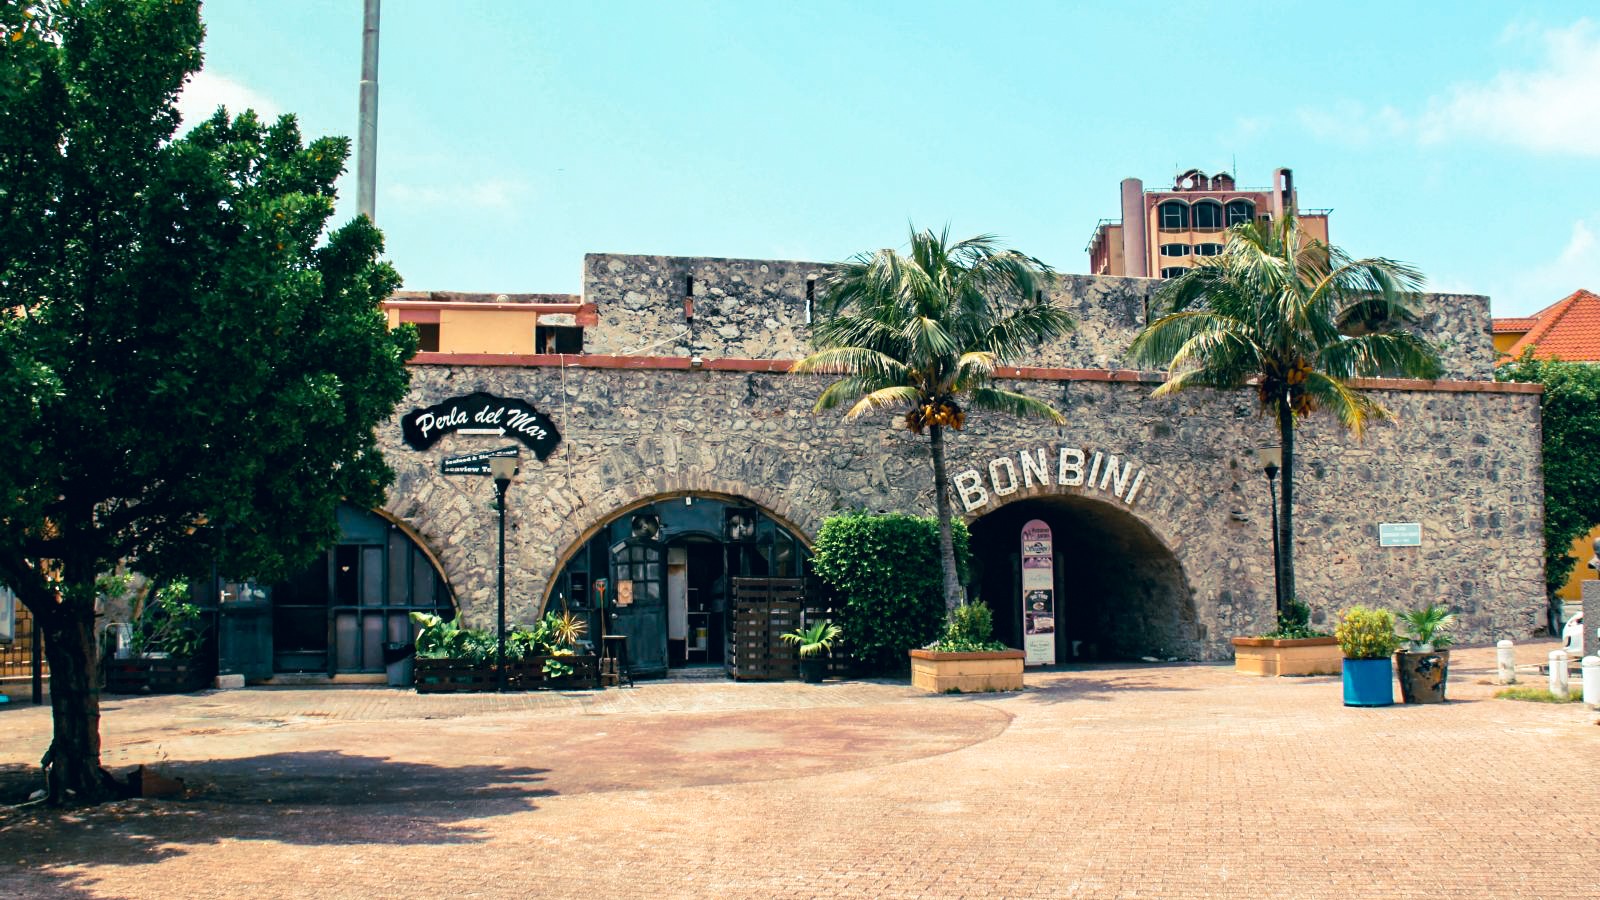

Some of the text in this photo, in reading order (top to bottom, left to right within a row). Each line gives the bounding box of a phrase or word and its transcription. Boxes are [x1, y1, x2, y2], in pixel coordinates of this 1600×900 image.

[415, 405, 548, 440] Perla del Mar
